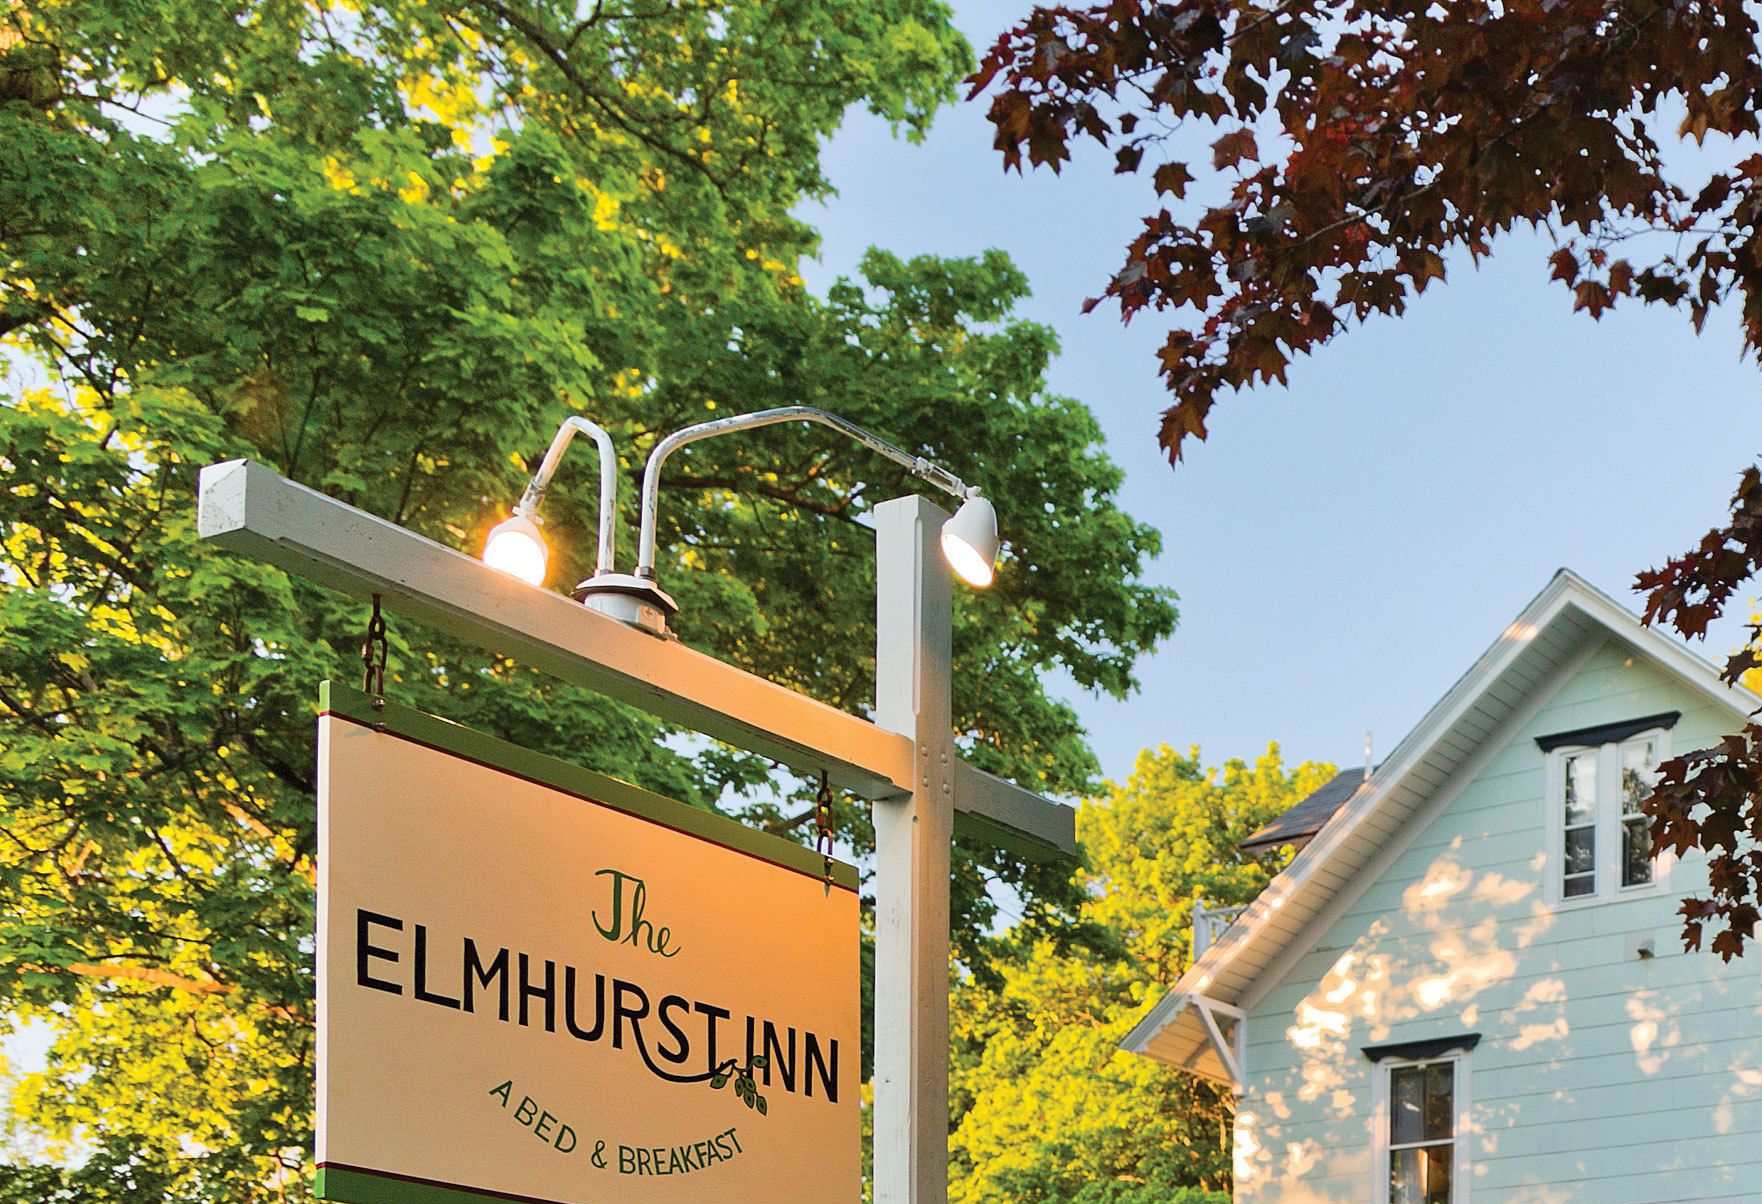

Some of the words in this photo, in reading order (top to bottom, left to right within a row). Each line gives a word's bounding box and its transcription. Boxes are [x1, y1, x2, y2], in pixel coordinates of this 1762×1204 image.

[591, 869, 682, 958] The
[356, 908, 737, 1083] ELMHURST
[745, 1015, 839, 1104] INN
[488, 1079, 514, 1109] A
[513, 1095, 577, 1154] BED
[590, 1139, 608, 1170] &
[618, 1127, 743, 1176] BREAKFAST
